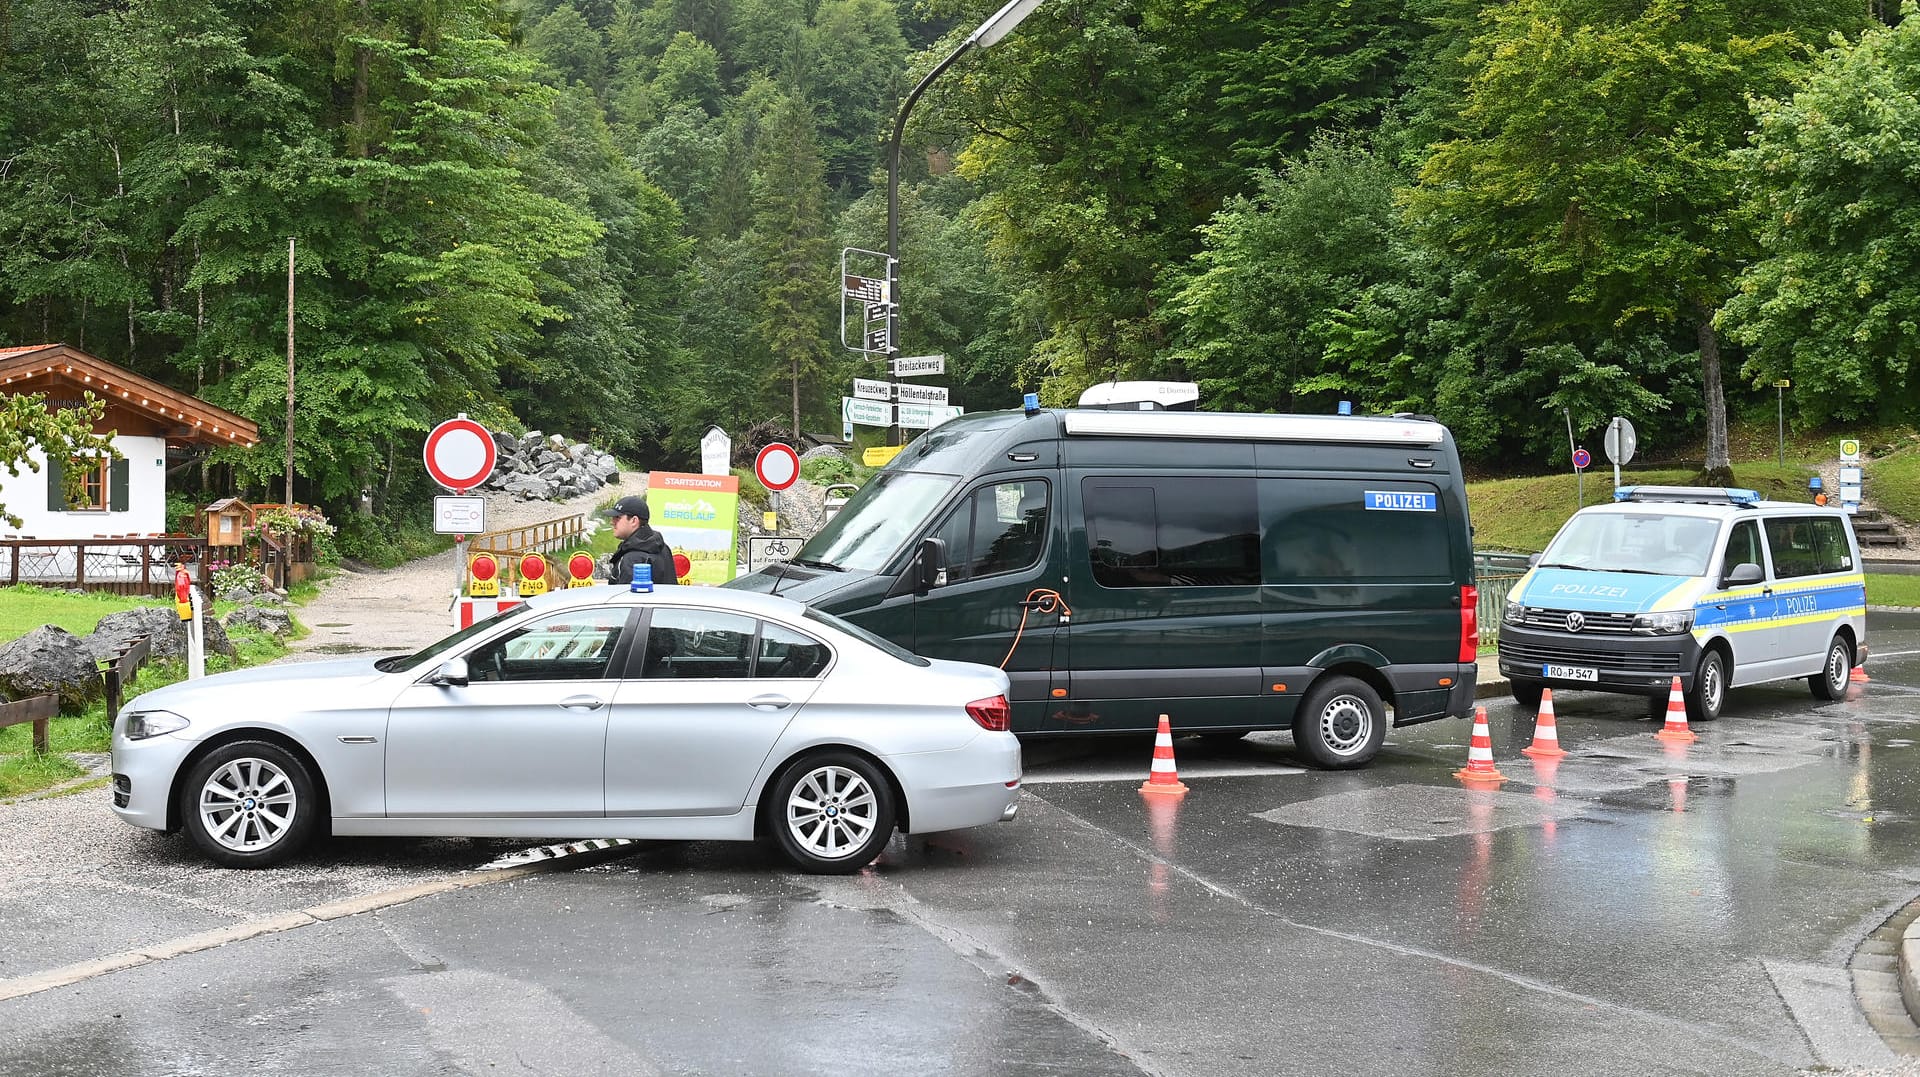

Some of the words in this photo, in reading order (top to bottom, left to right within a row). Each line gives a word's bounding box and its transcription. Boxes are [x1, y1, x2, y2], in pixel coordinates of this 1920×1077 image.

[898, 360, 940, 372] Breitackerweg
[856, 382, 888, 398] Kreuzeckweg
[900, 387, 946, 401] Höllentalstraße
[664, 477, 722, 488] STARTSTATION
[1375, 494, 1426, 508] POLIZEI
[664, 510, 716, 521] BERGLAUF
[472, 582, 494, 591] FMO
[522, 581, 543, 591] FMO
[1551, 584, 1629, 598] POLIZEI
[1786, 594, 1817, 614] POLIZEI
[1550, 667, 1562, 677] RO
[1568, 668, 1574, 676] P
[1576, 670, 1593, 679] 547
